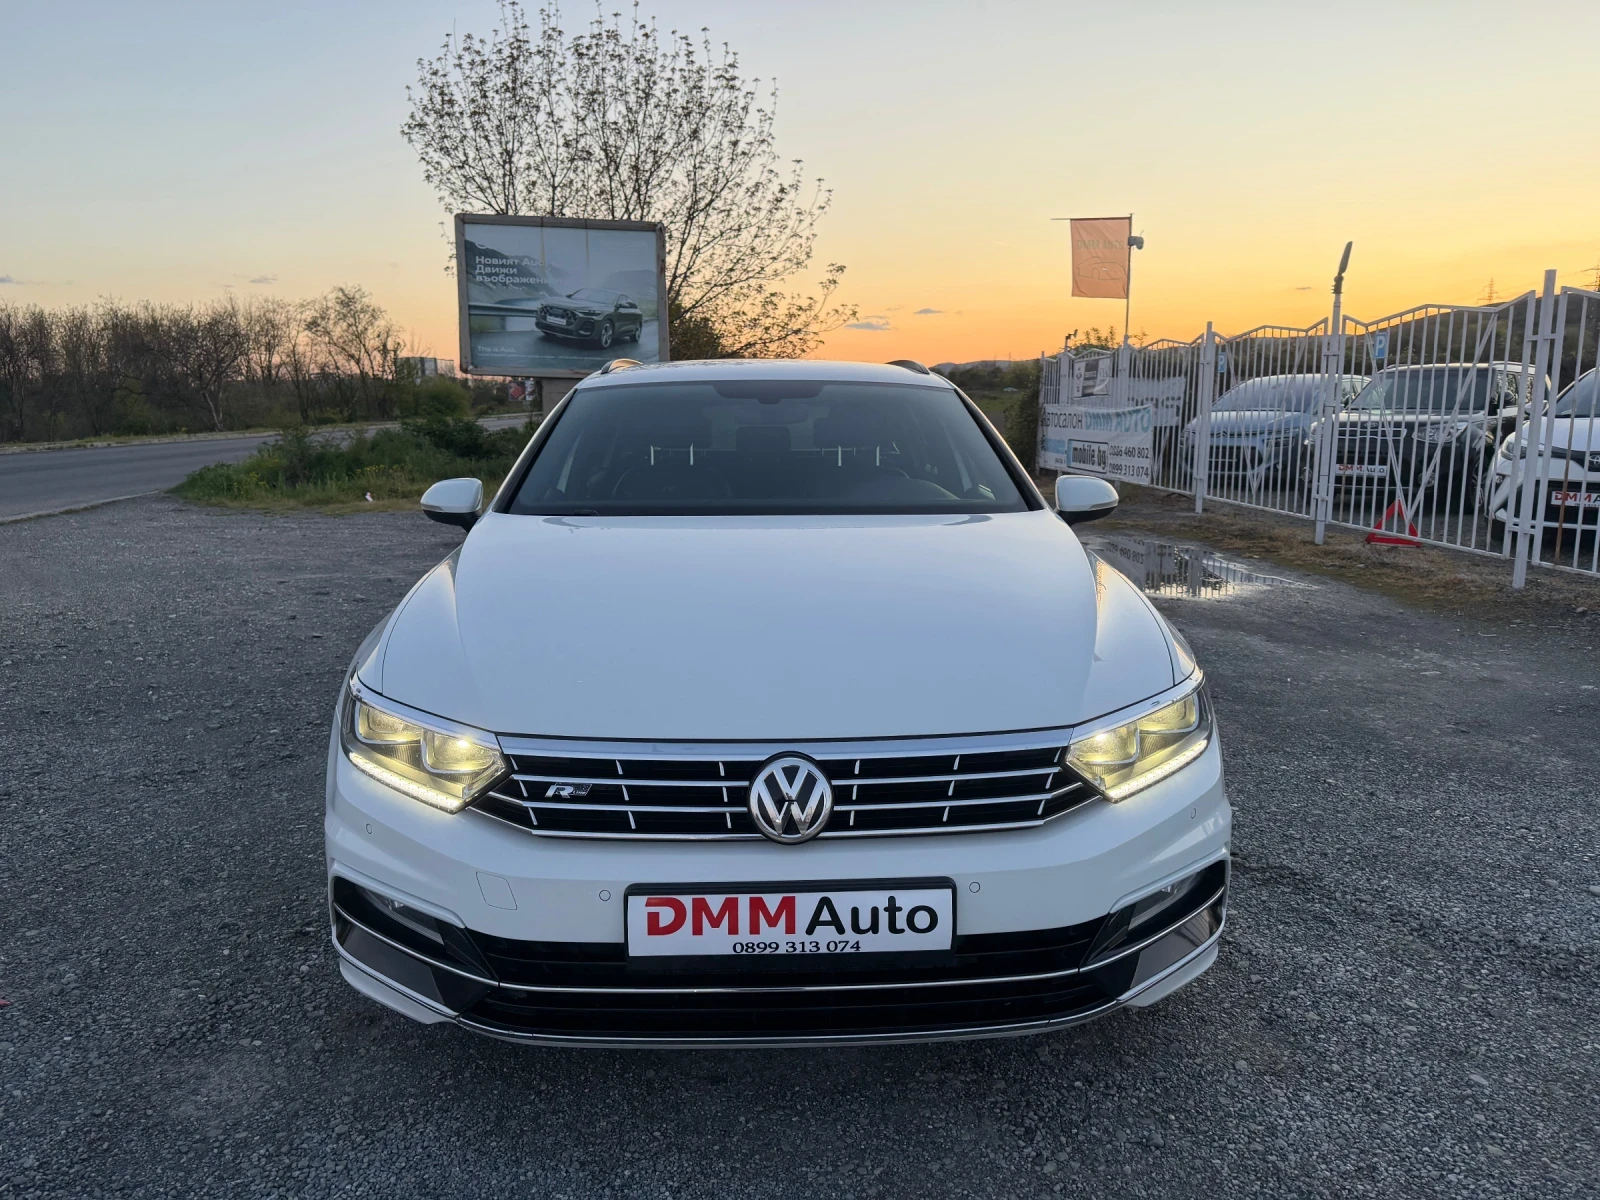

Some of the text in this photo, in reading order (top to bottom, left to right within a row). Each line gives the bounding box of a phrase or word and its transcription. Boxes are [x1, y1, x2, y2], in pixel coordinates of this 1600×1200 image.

[475, 256, 519, 266] Новият
[475, 265, 518, 275] Движи
[1124, 446, 1136, 458] 460
[1137, 447, 1149, 459] 802
[1109, 462, 1149, 478] 0899 313 074
[732, 940, 861, 954] 0899 313 074
